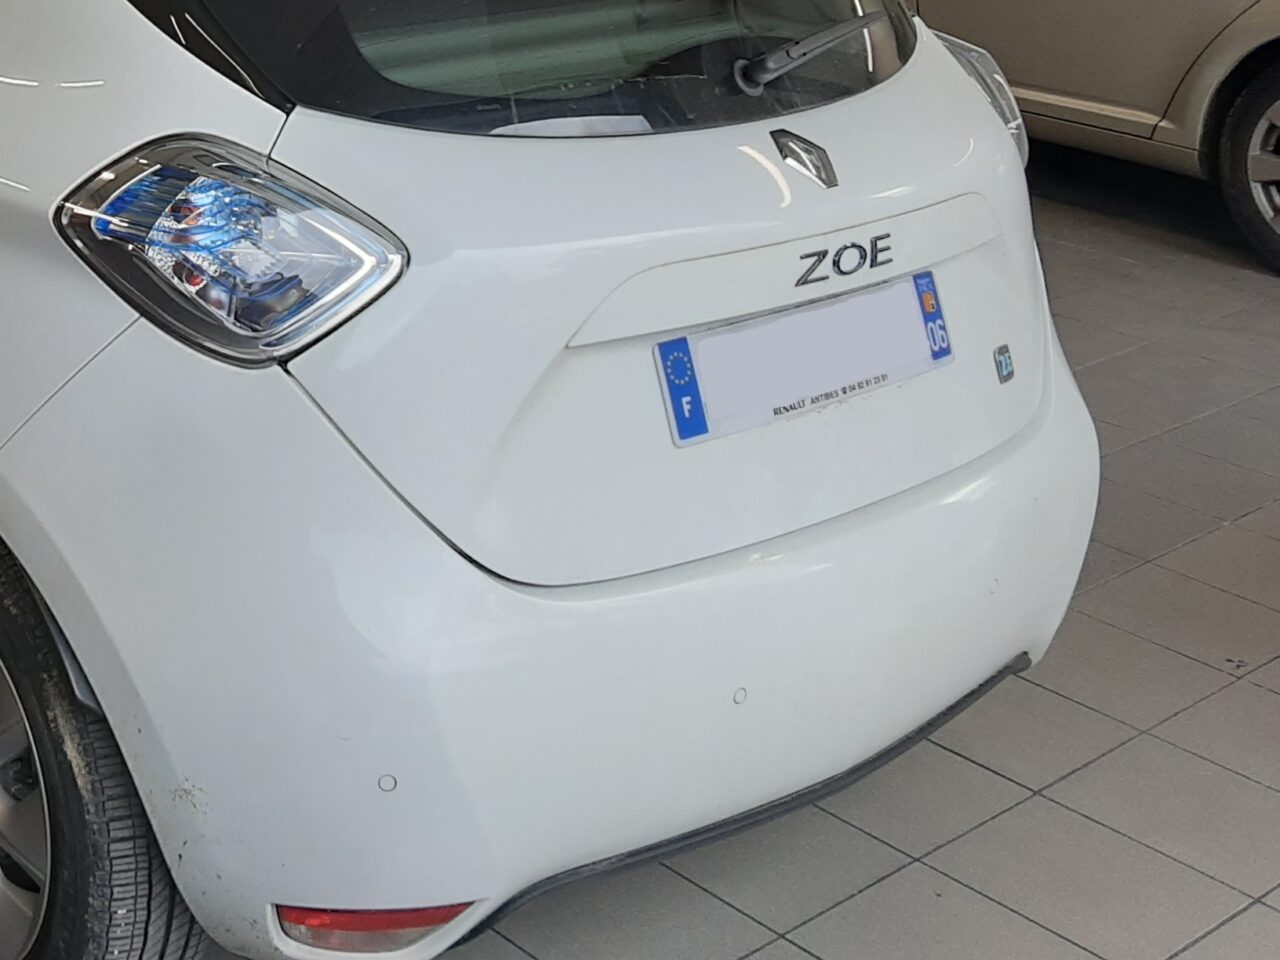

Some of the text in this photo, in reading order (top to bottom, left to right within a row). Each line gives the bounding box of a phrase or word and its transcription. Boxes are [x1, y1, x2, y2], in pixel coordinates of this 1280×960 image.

[795, 232, 893, 288] ZOE
[927, 318, 948, 352] 06
[681, 395, 692, 418] F
[772, 399, 806, 417] RENAULT
[810, 389, 840, 406] ANTIBES
